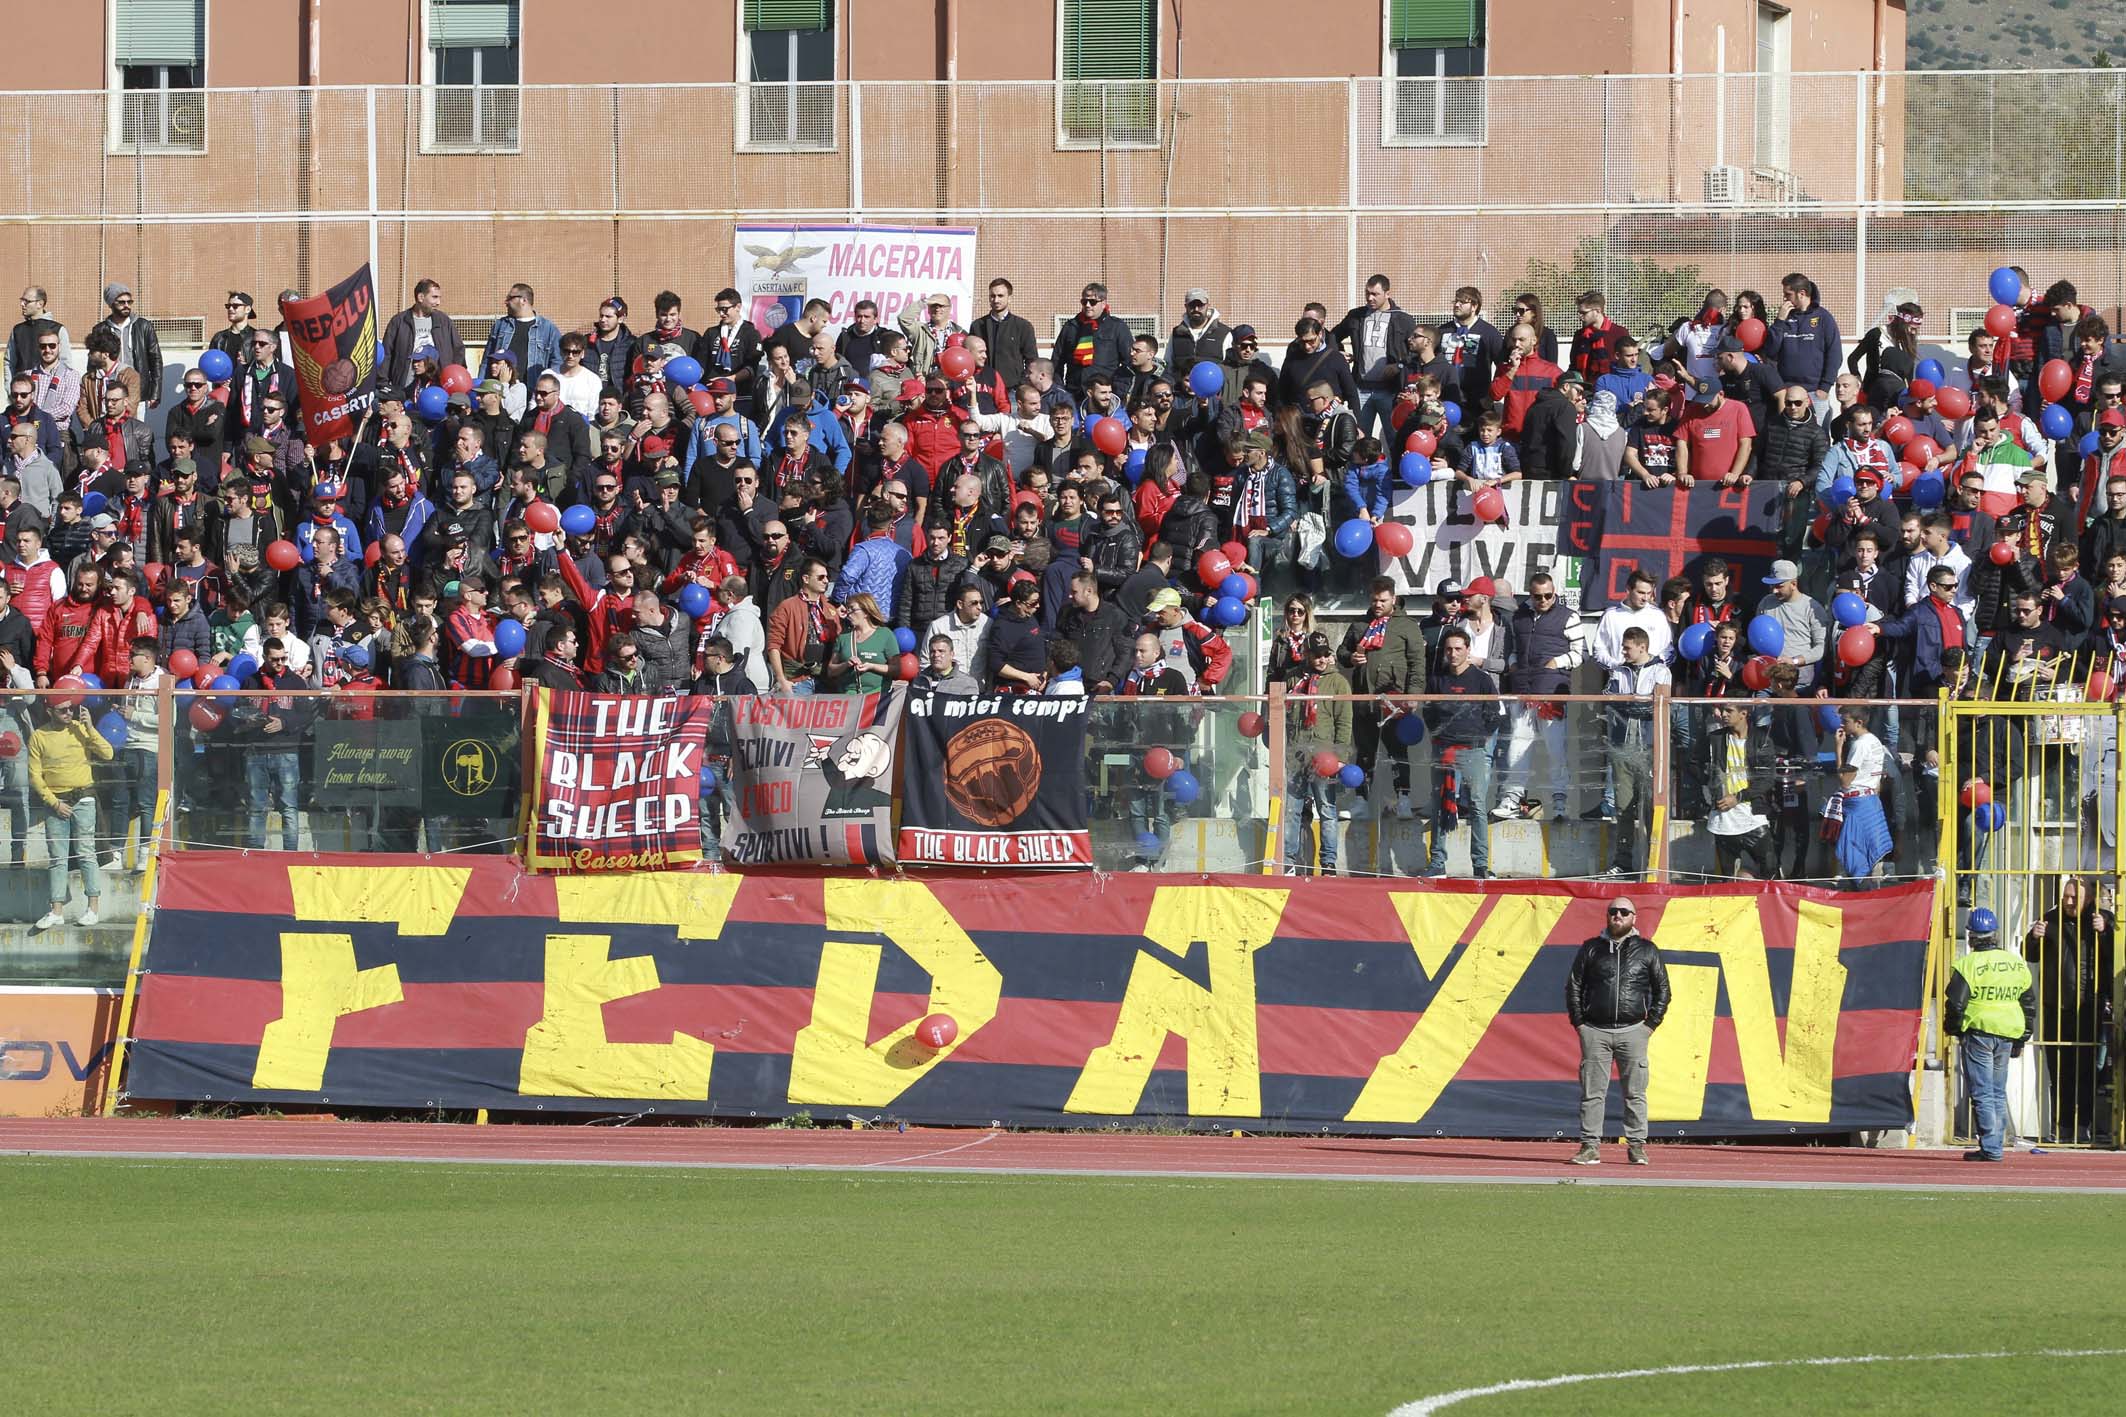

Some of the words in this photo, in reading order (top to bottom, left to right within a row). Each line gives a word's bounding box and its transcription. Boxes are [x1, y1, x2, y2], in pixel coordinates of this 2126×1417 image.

[828, 244, 962, 280] MACERATA
[752, 283, 792, 293] CASERTANA
[1364, 320, 1388, 347] H
[1397, 541, 1556, 591] VIVE
[592, 697, 677, 737] THE
[736, 695, 849, 729] FASTIDIOSI
[910, 692, 934, 717] ai
[944, 695, 1003, 718] miei
[1012, 695, 1089, 723] tempi
[327, 743, 374, 764] Always
[379, 746, 413, 765] away
[550, 742, 697, 790] BLACK
[737, 737, 796, 771] SCHIVI
[324, 767, 354, 788] from
[547, 794, 691, 840] SHEEP
[571, 848, 664, 869] Caserta
[731, 827, 813, 864] SPORTIVI
[914, 832, 946, 860] THE
[954, 836, 1010, 863] BLACK
[1017, 835, 1073, 862] SHEEP
[252, 866, 1848, 1124] FEDAYN
